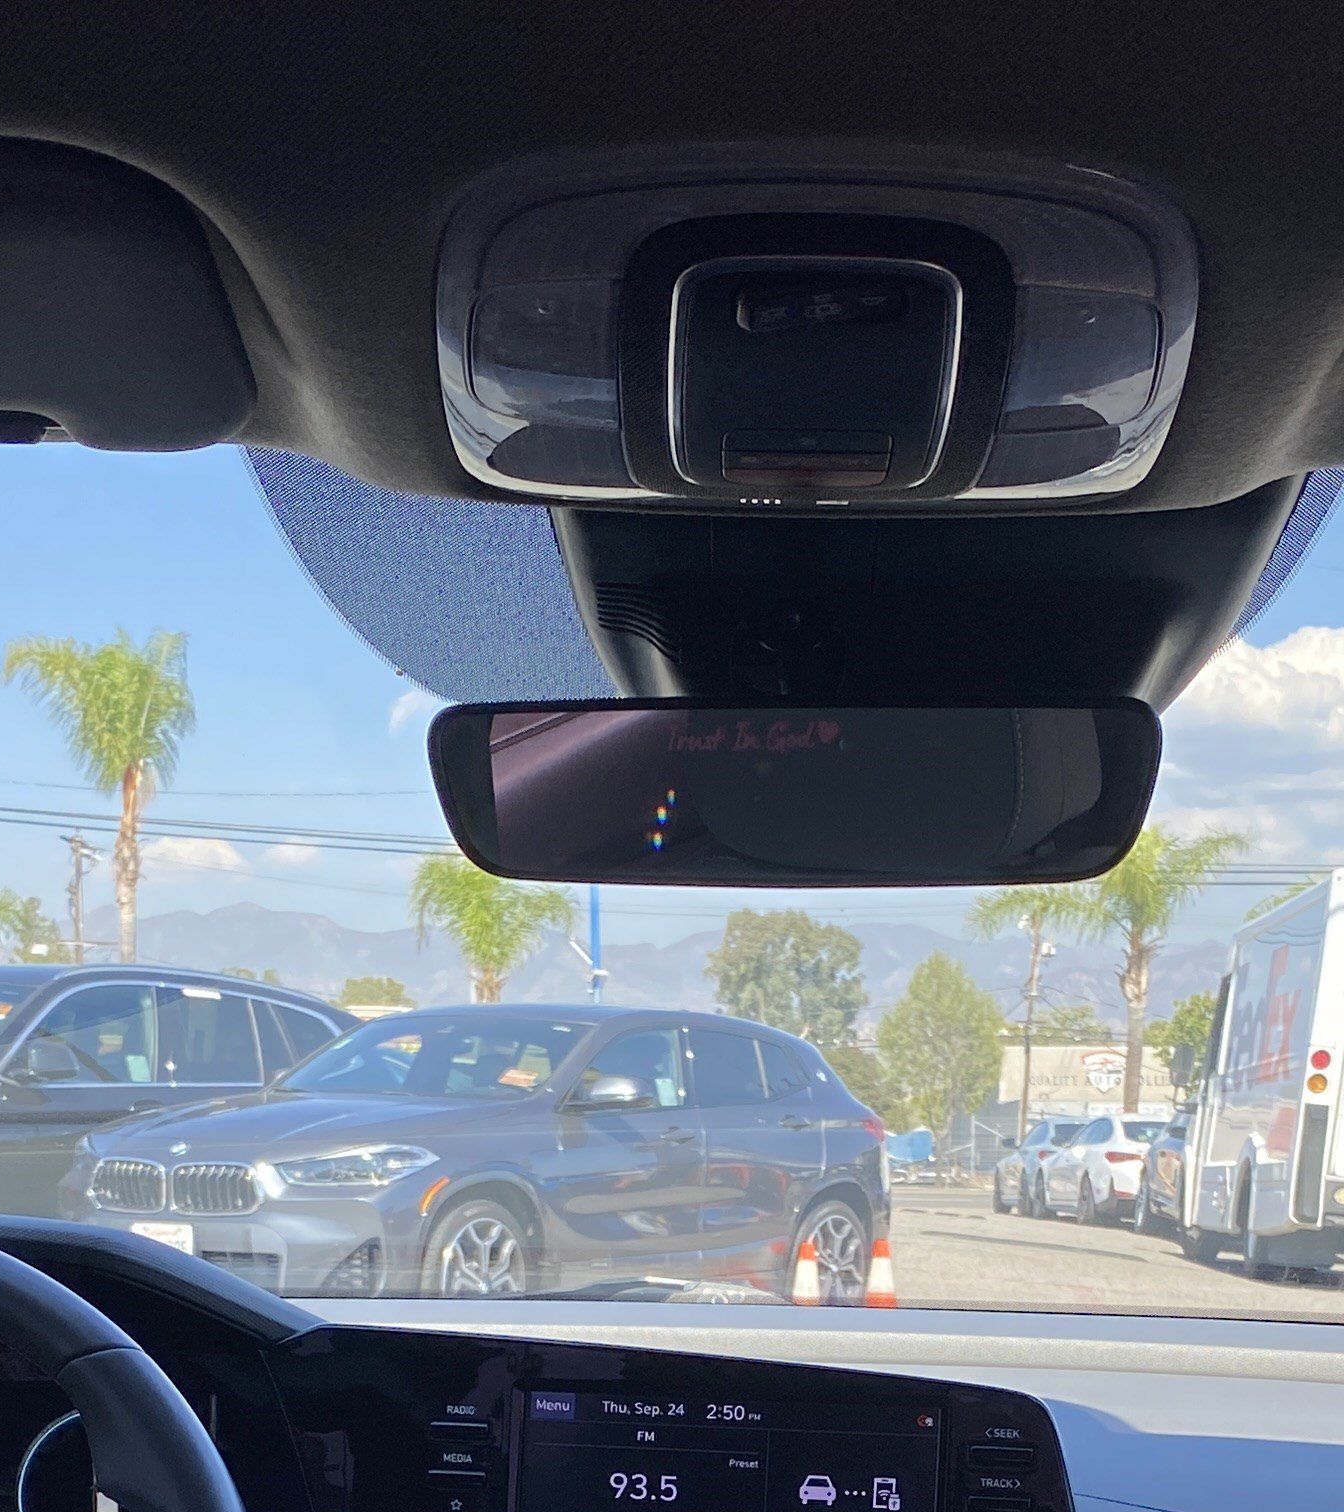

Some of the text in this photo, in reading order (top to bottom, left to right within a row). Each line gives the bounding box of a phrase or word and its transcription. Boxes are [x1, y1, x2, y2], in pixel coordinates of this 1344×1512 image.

[446, 1405, 476, 1415] RADIO
[536, 1399, 570, 1411] Menu
[634, 1403, 663, 1418] Sep.
[668, 1404, 685, 1416] 24
[707, 1404, 745, 1420] 2:50
[637, 1431, 655, 1441] FM
[994, 1429, 1020, 1438] SEEK
[443, 1453, 472, 1463] MEDIA
[729, 1458, 759, 1470] Preset
[609, 1472, 678, 1501] 93.5
[980, 1478, 1013, 1488] TRACK
